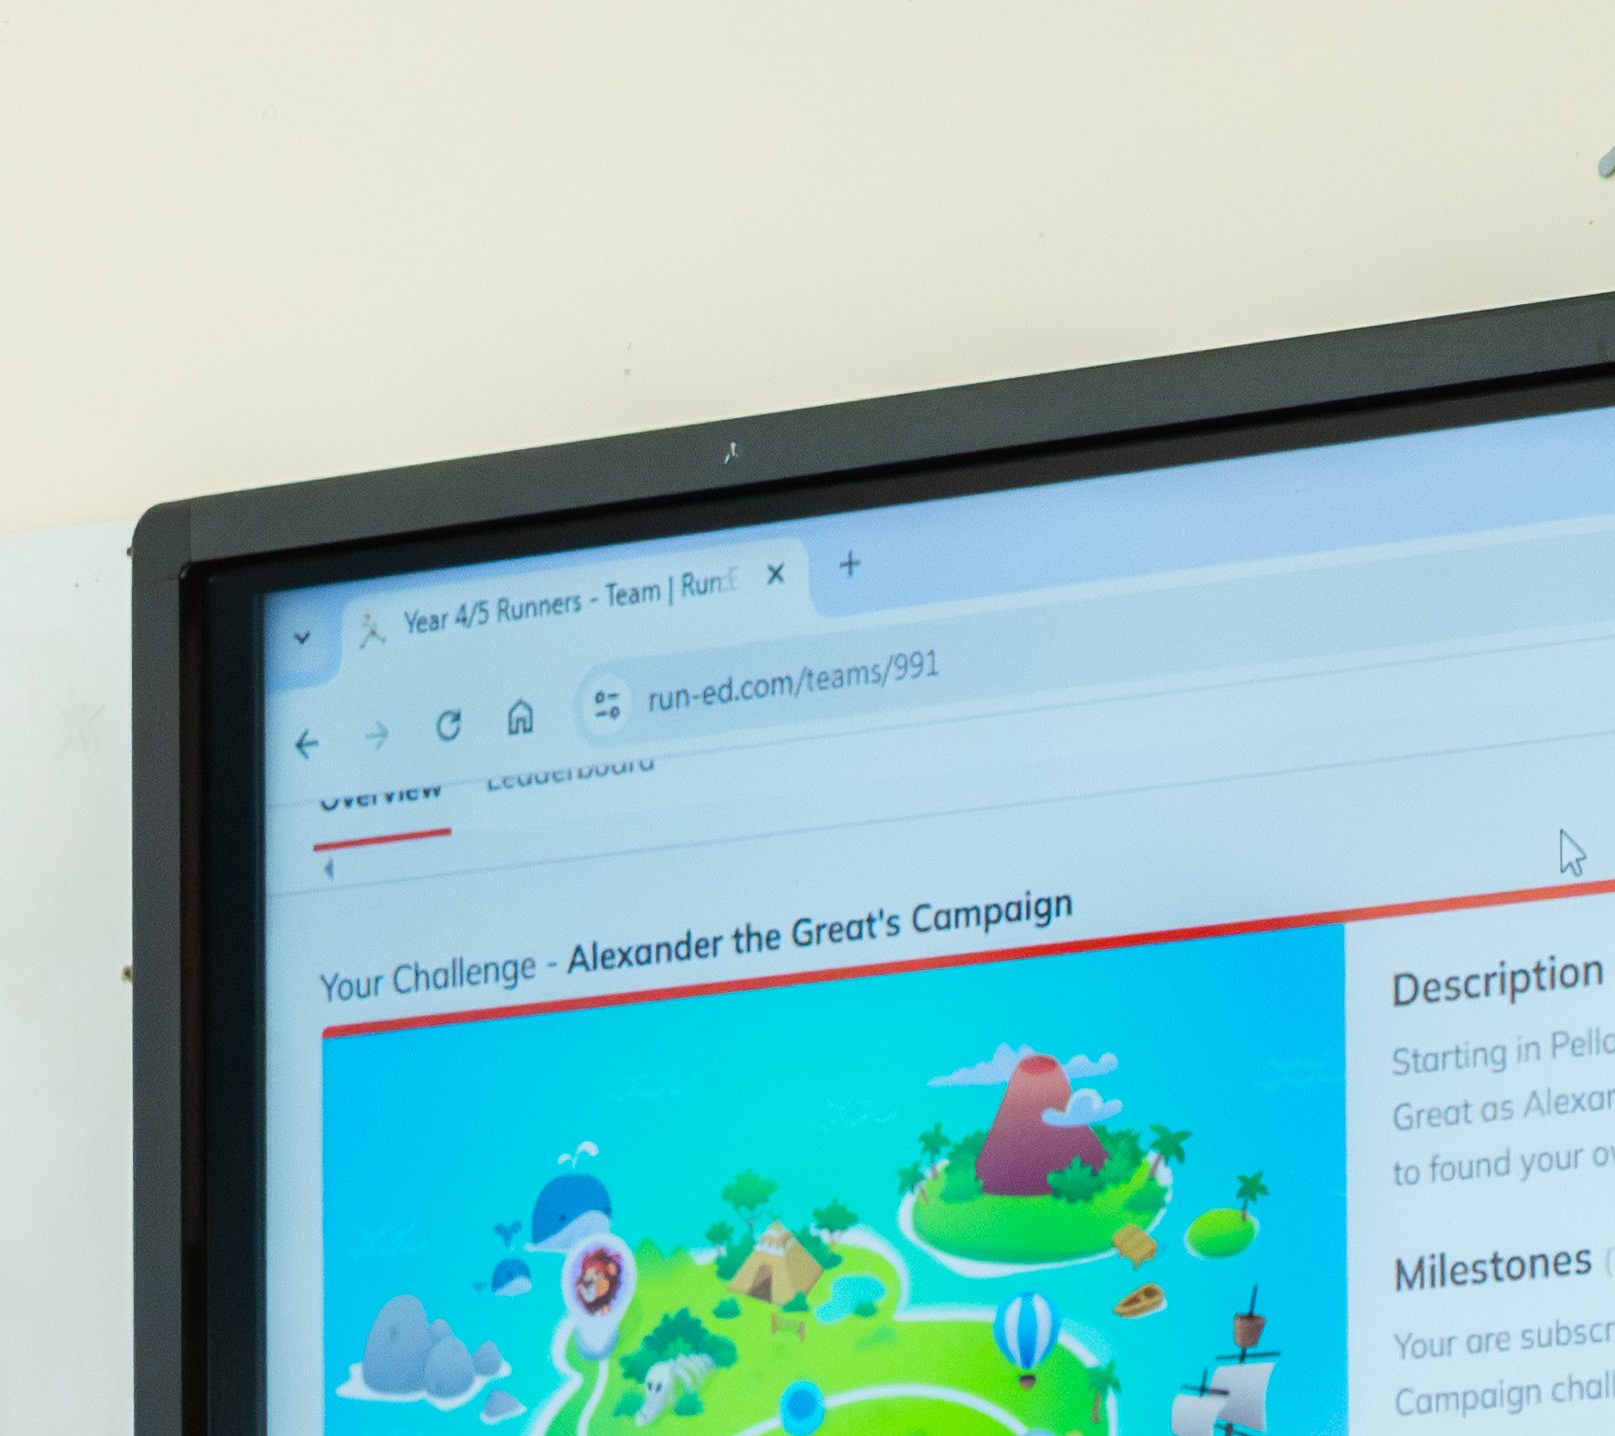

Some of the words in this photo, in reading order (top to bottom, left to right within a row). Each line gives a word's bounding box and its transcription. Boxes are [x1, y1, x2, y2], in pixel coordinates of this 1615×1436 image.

[403, 610, 449, 635] Year
[453, 599, 490, 630] 4/5
[496, 594, 583, 623] Runners
[603, 581, 662, 608] Team
[648, 649, 940, 713] run-ed.com/teams/991
[319, 972, 385, 1003] Your
[392, 956, 537, 996] Challenge
[566, 929, 724, 975] Alexander
[732, 922, 782, 955] the
[792, 908, 902, 949] Great's
[912, 890, 1074, 935] Campaign
[1392, 954, 1605, 1008] Description
[1391, 1041, 1508, 1077] Starting
[1516, 1034, 1542, 1063] in
[1392, 1099, 1474, 1132] Great
[1479, 1098, 1515, 1124] as
[1392, 1161, 1422, 1187] to
[1428, 1147, 1512, 1183] found
[1519, 1147, 1585, 1183] your
[1395, 1248, 1593, 1292] Milestones
[1393, 1332, 1458, 1361] Your
[1465, 1330, 1512, 1356] are
[1394, 1379, 1543, 1419] Campaign
